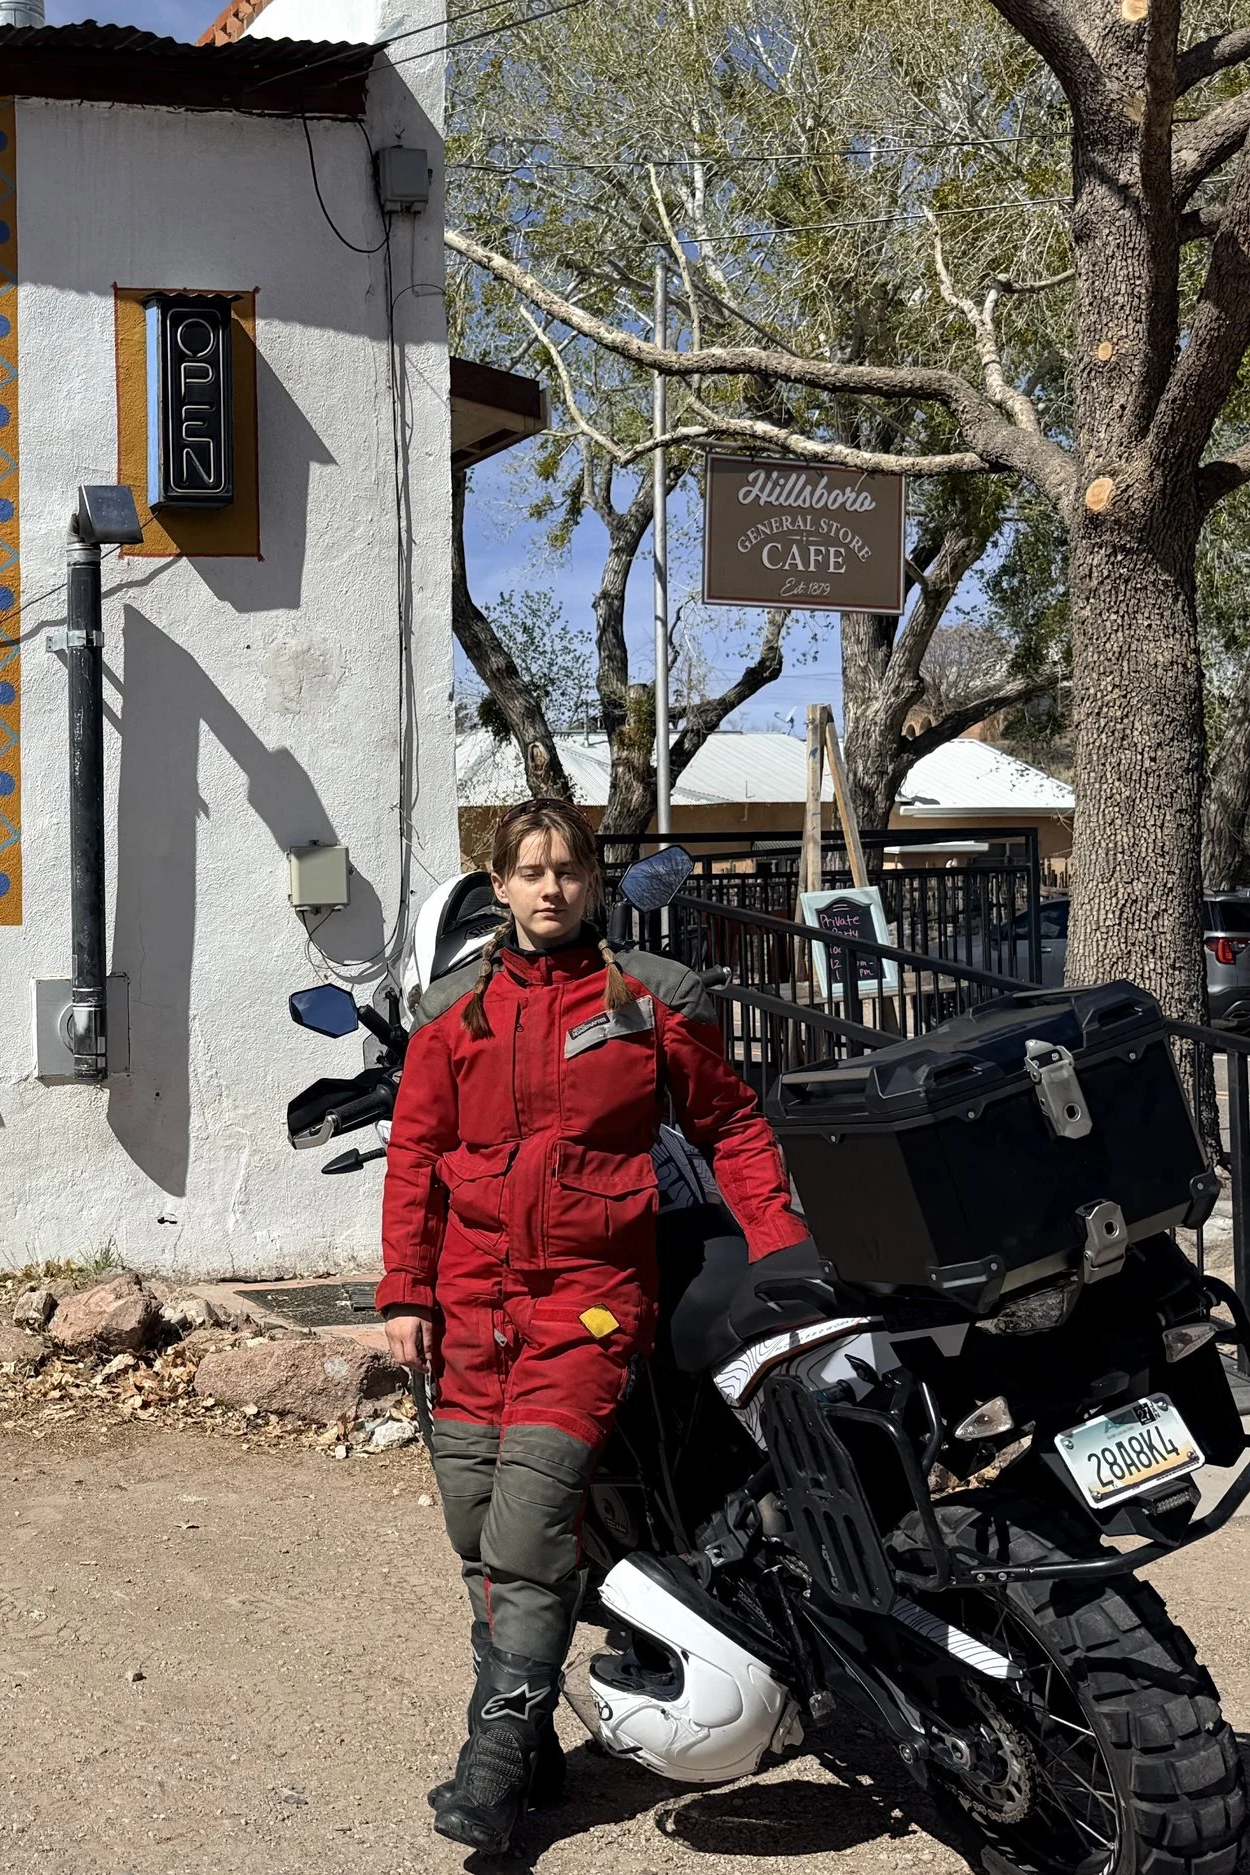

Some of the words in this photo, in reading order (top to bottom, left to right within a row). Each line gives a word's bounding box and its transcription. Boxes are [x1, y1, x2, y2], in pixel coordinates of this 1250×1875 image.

[176, 318, 215, 486] OPEN
[738, 469, 876, 513] Hillsboro
[737, 515, 815, 554] GENERAL
[819, 518, 872, 563] STORE
[761, 543, 847, 574] CAFE
[807, 582, 831, 597] 1879
[820, 914, 860, 929] Private
[1087, 1426, 1180, 1489] 28A8K4
